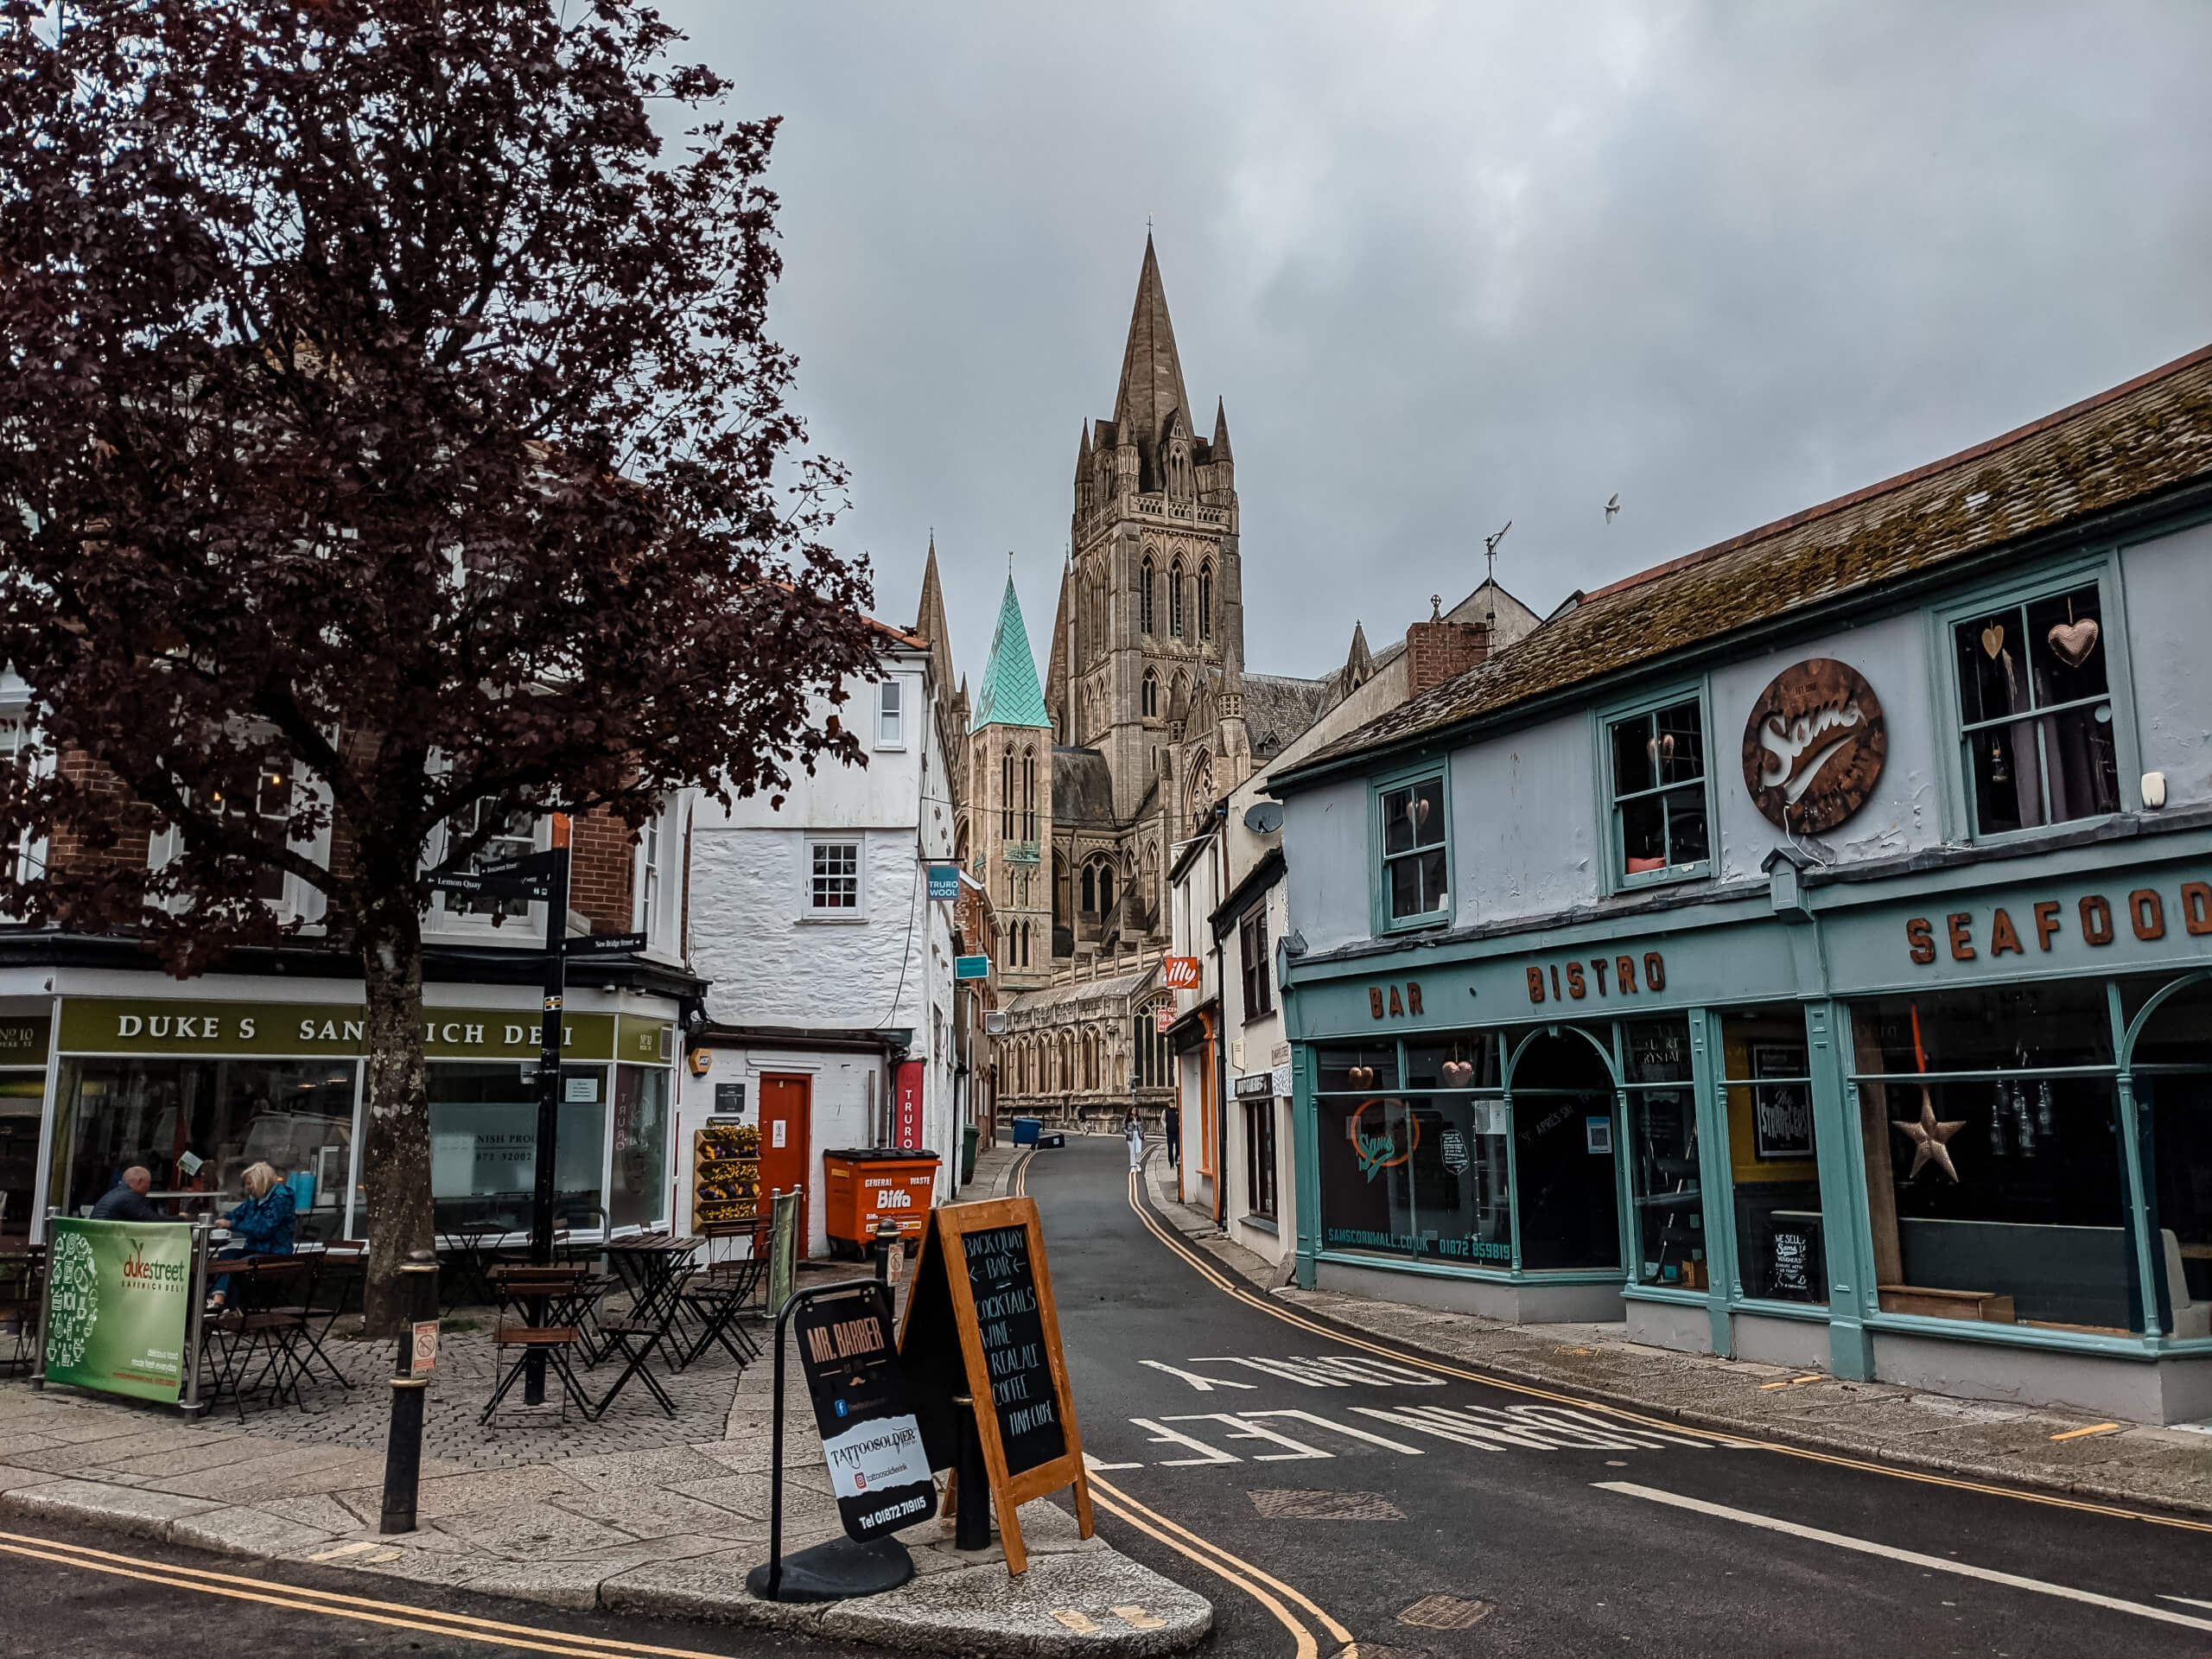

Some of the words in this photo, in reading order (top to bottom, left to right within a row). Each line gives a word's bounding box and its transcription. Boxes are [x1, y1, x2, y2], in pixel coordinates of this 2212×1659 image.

[437, 877, 462, 887] Lemon
[462, 880, 481, 890] Quay
[930, 888, 957, 897] WOOL
[1906, 881, 2212, 965] SEAFOOD
[606, 939, 620, 949] Bridge
[1168, 961, 1197, 986] illy
[1526, 951, 1667, 1003] BISTRO
[1369, 982, 1424, 1019] BAR
[20, 1028, 34, 1040] 10
[118, 1015, 219, 1039] DUKE
[299, 1020, 484, 1044] SANICH
[504, 1025, 573, 1046] DEI
[903, 1090, 913, 1149] TRURO
[910, 1176, 931, 1185] WASTE
[877, 1189, 911, 1209] Biffa
[963, 1234, 995, 1258] BACK
[995, 1230, 1025, 1257] QUAY
[1439, 1238, 1469, 1256] 01872
[1472, 1242, 1510, 1261] 859819
[986, 1255, 1012, 1280] BAR
[975, 1287, 1036, 1321] COCKTAILS
[807, 1326, 837, 1363] MR.
[833, 1316, 886, 1358] BARBER
[991, 1348, 1022, 1376] REAL
[992, 1374, 1030, 1407] COFFEE
[830, 1427, 916, 1469] TATTOOSOLDIER
[859, 1514, 874, 1529] Tel
[874, 1504, 901, 1524] 01872
[899, 1496, 927, 1516] 719115
